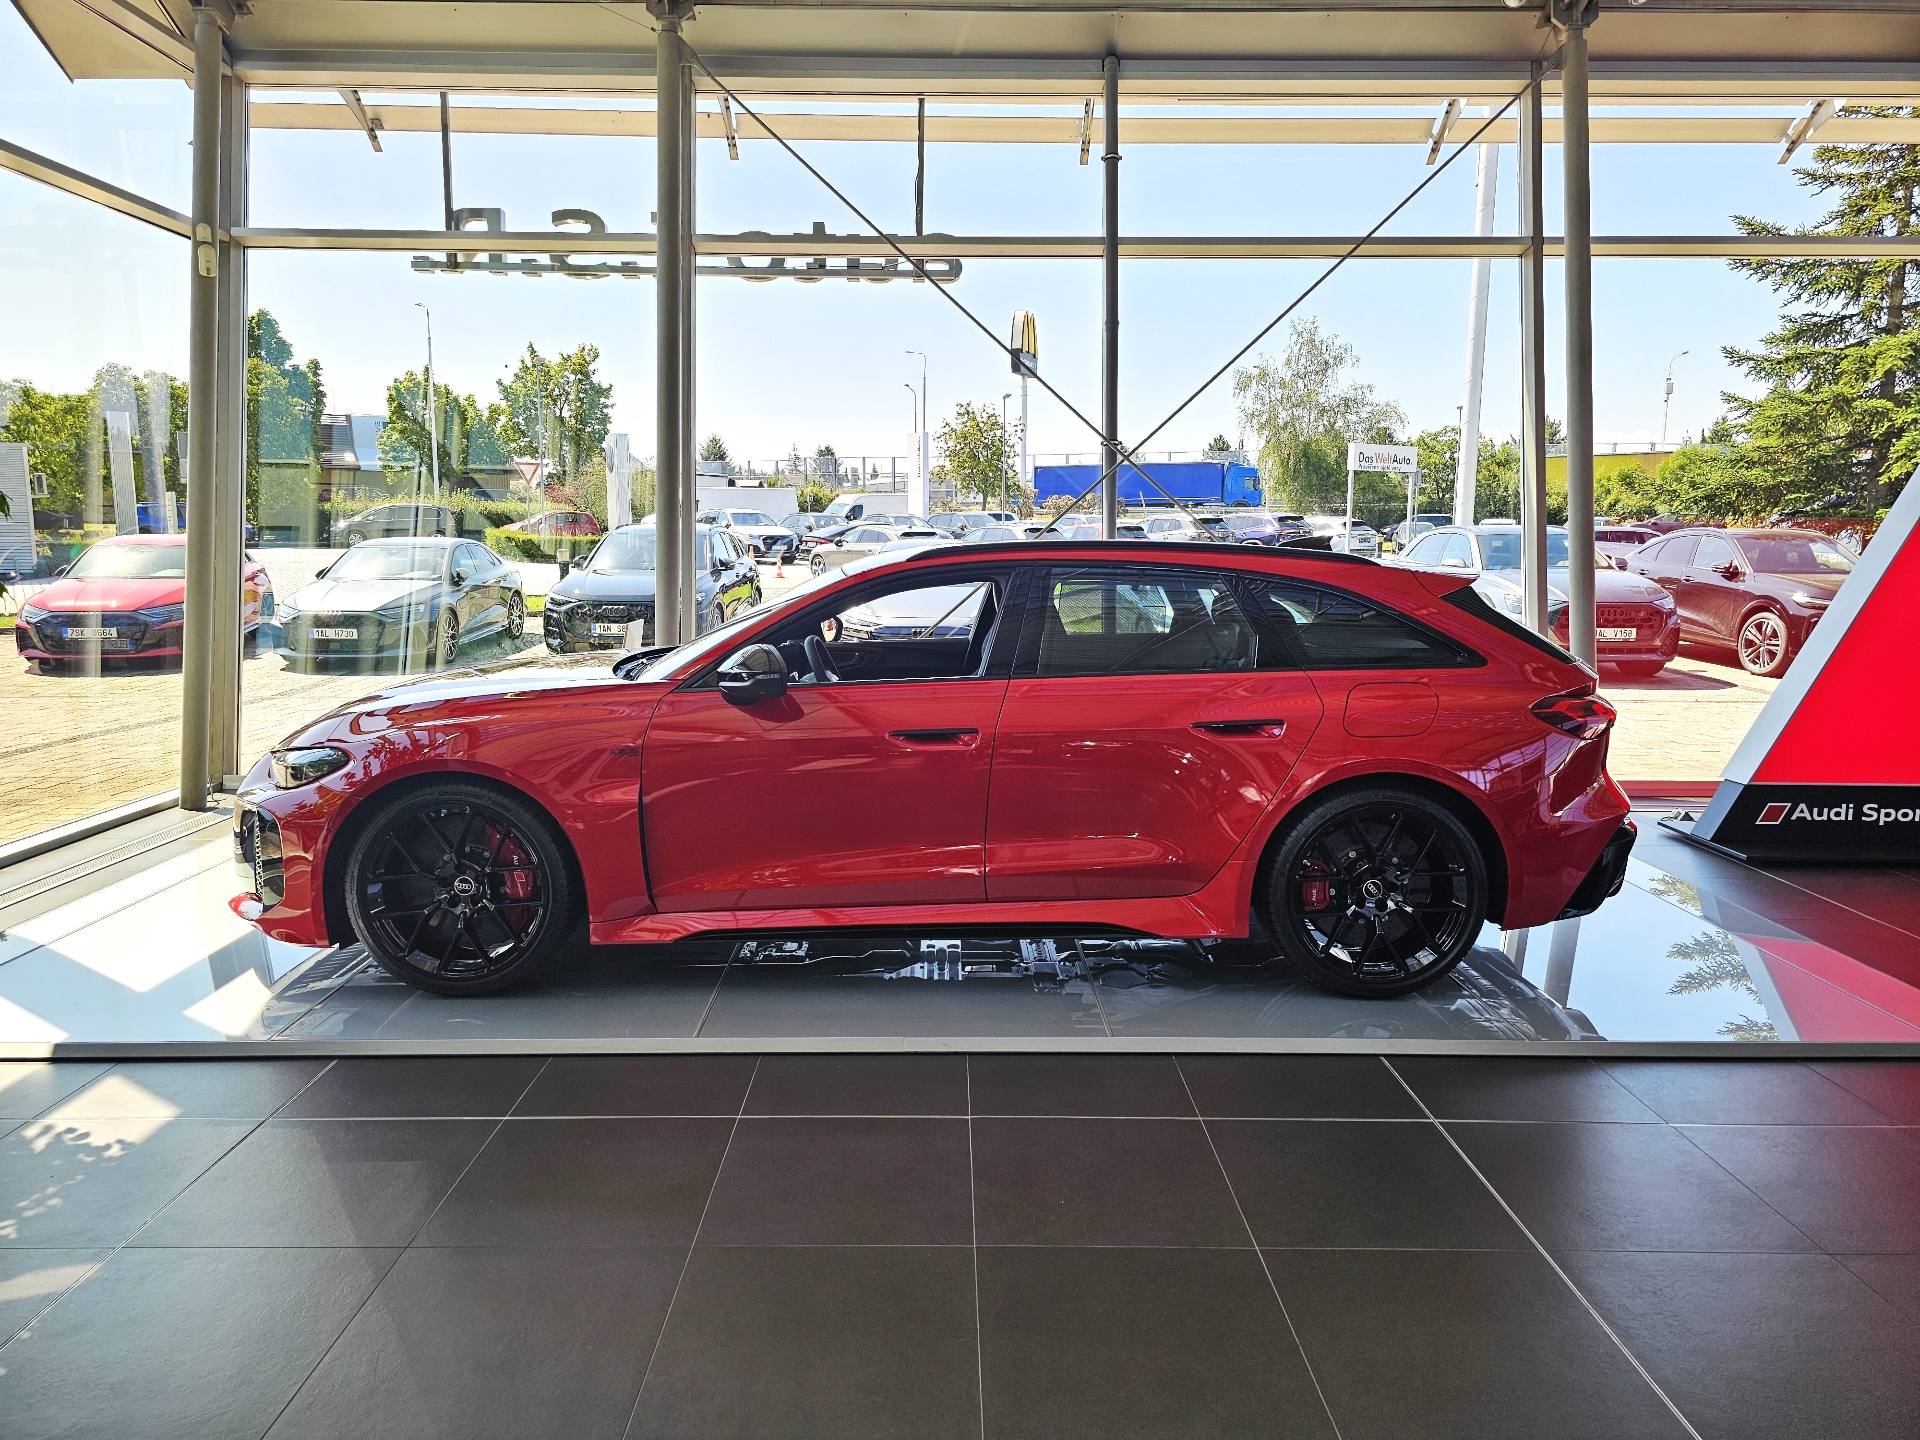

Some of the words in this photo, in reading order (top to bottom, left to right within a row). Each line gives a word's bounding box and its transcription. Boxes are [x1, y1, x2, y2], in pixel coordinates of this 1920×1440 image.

[1358, 451, 1374, 464] Das
[69, 628, 86, 637] 7SK
[91, 628, 113, 637] 0664
[598, 624, 612, 633] 1AN
[616, 624, 627, 633] S8
[315, 629, 330, 638] 1AL
[334, 629, 354, 638] H730
[1613, 629, 1633, 638] V158
[1790, 803, 1854, 821] Audi
